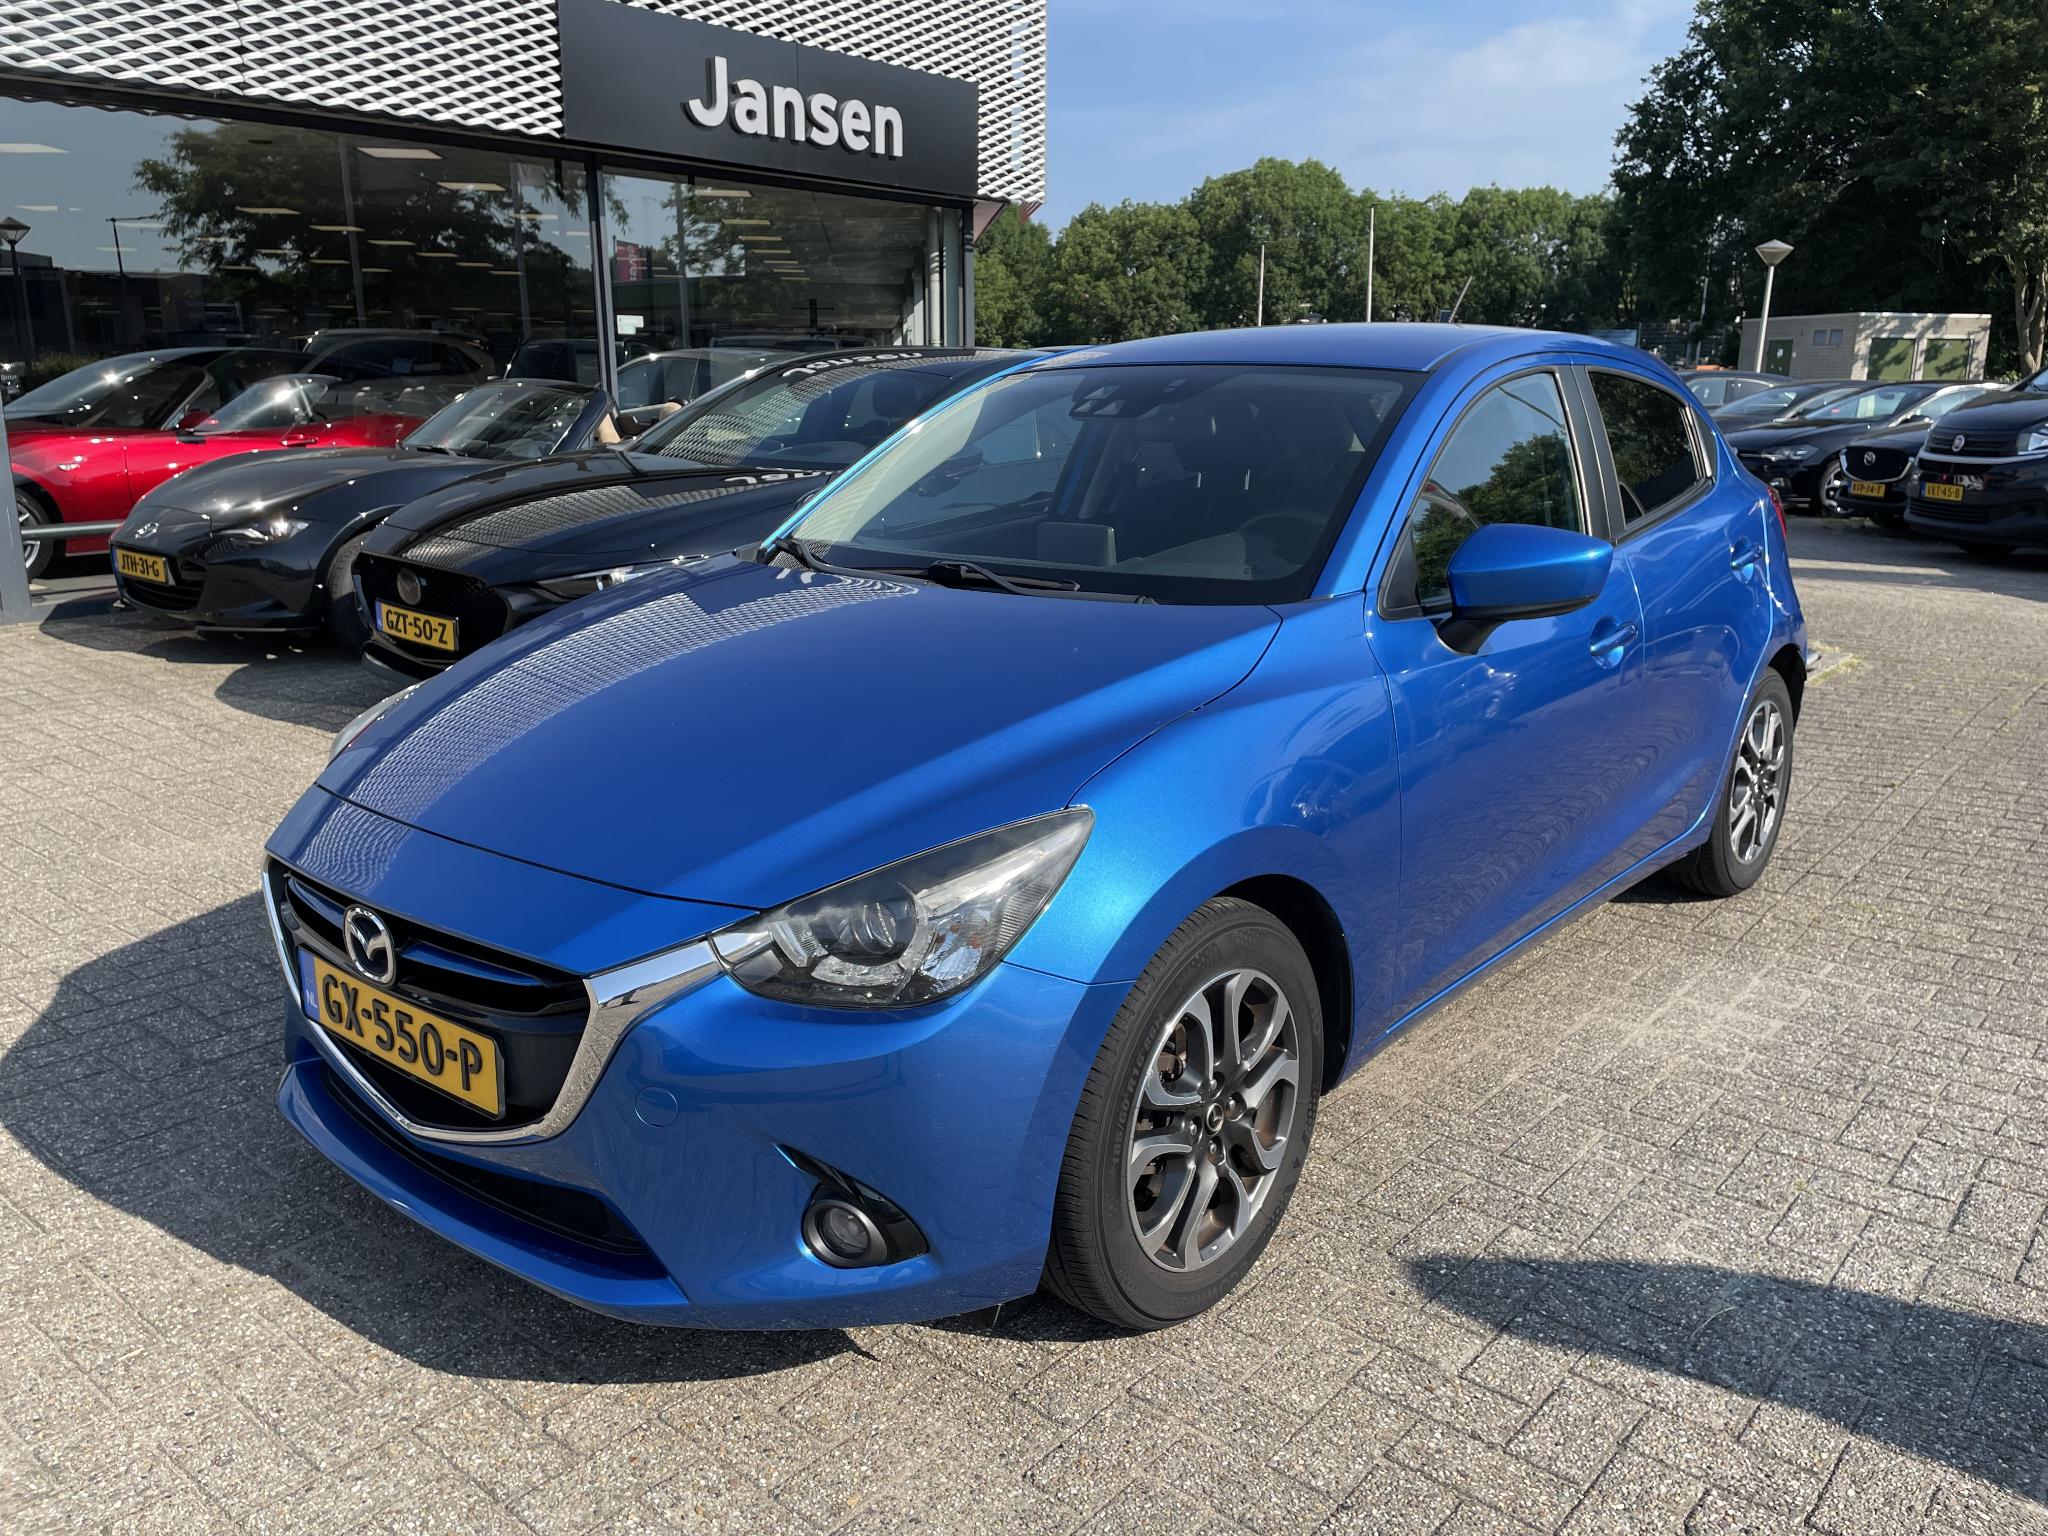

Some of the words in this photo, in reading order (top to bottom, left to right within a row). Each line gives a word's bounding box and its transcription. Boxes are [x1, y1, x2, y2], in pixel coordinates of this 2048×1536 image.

[687, 55, 904, 158] Jansen
[121, 552, 160, 577] JTH-31-G
[385, 609, 448, 645] GZT-50-Z
[305, 988, 318, 1009] NL
[321, 973, 483, 1092] GX-550-P
